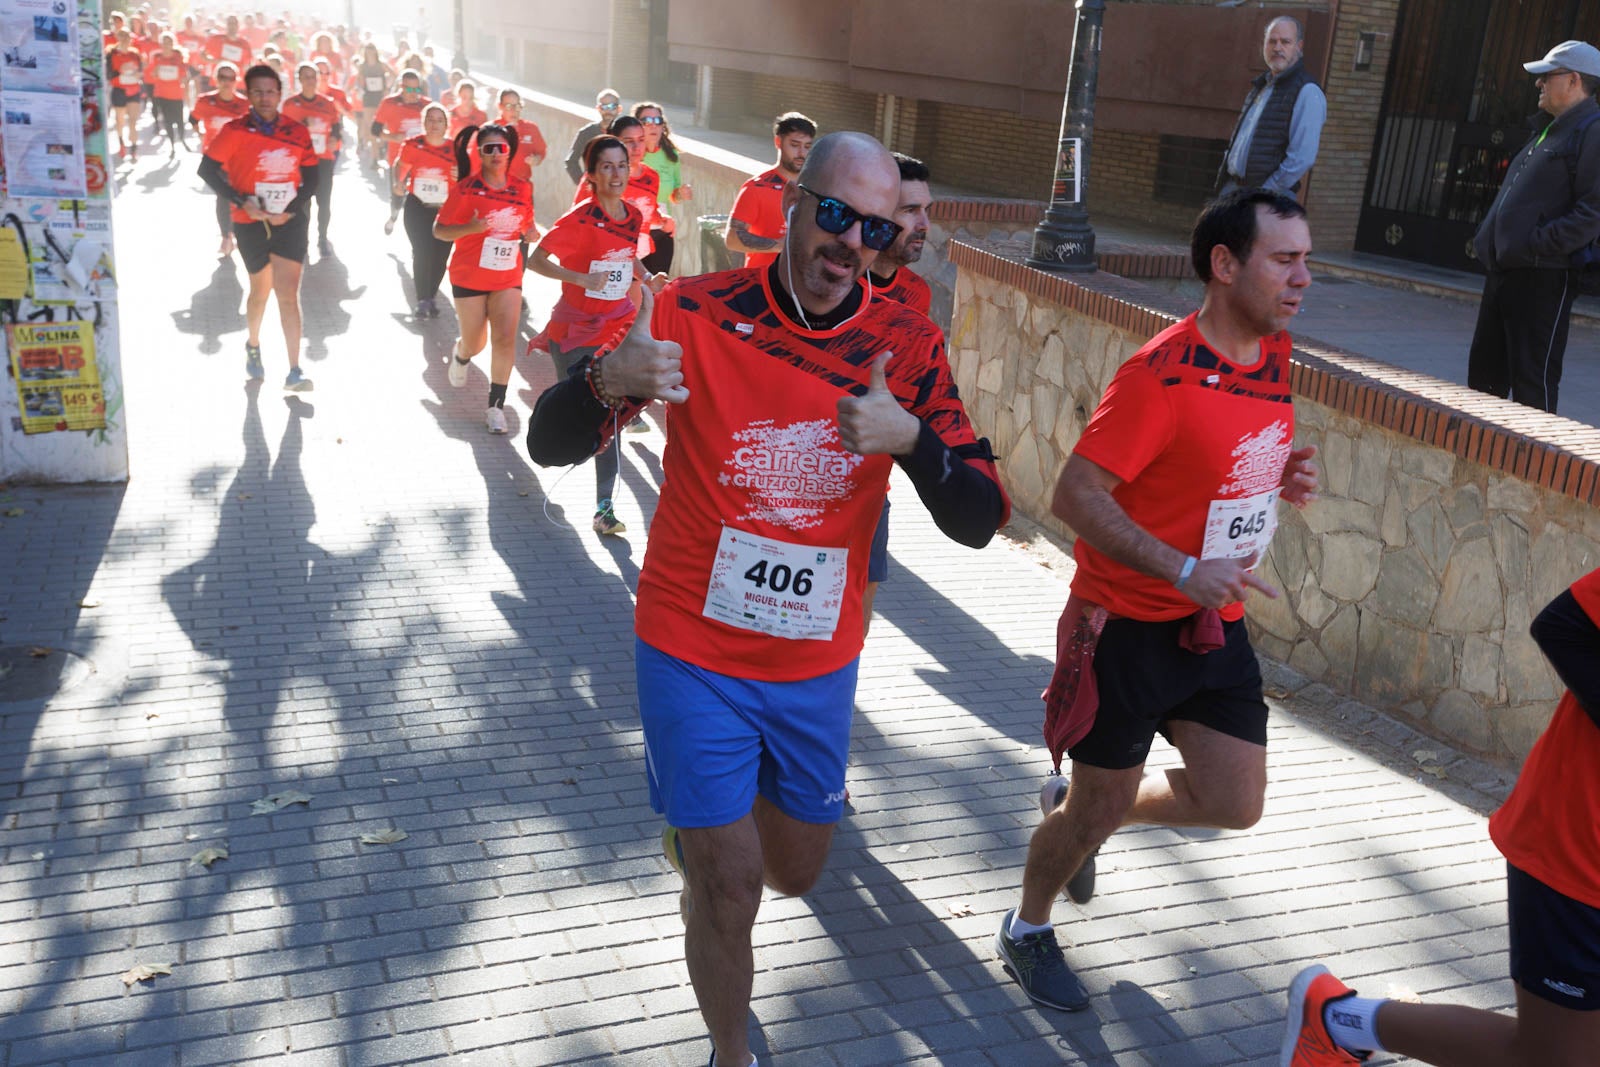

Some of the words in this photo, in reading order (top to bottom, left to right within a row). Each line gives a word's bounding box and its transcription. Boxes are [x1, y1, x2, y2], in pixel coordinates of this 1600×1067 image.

[266, 190, 287, 199] 727
[494, 246, 512, 256] 182
[604, 270, 622, 282] 58
[17, 328, 80, 342] MOLINA
[61, 345, 86, 371] B
[64, 392, 87, 406] 149
[734, 447, 848, 476] carrera
[733, 473, 846, 496] cruzroja.es
[768, 498, 793, 507] NOV
[798, 500, 826, 508] 2023
[1228, 510, 1266, 539] 645
[744, 559, 814, 596] 406
[744, 592, 778, 607] MIGUEL
[781, 600, 810, 612] ANGEL
